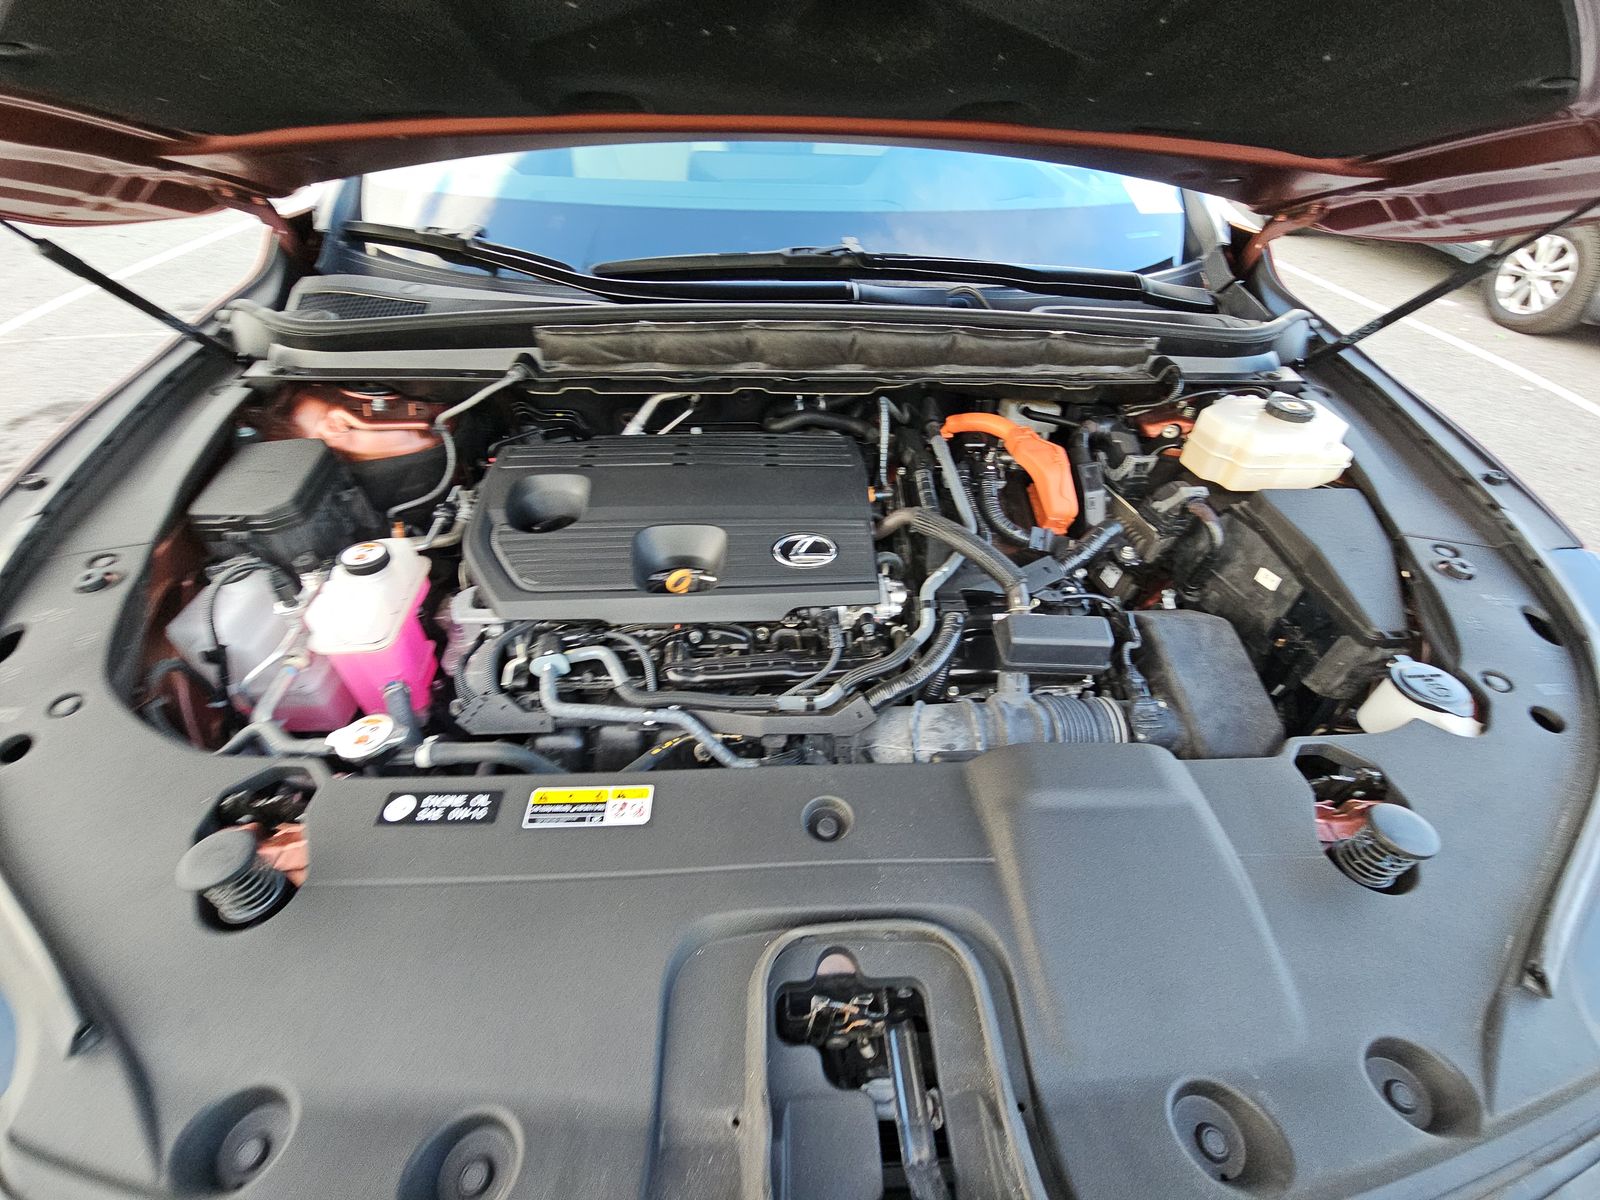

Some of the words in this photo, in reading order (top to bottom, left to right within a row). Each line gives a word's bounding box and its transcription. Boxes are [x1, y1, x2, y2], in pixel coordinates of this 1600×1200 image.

[420, 794, 468, 807] ENGINE
[469, 794, 491, 807] OIL
[415, 807, 446, 821] SAE
